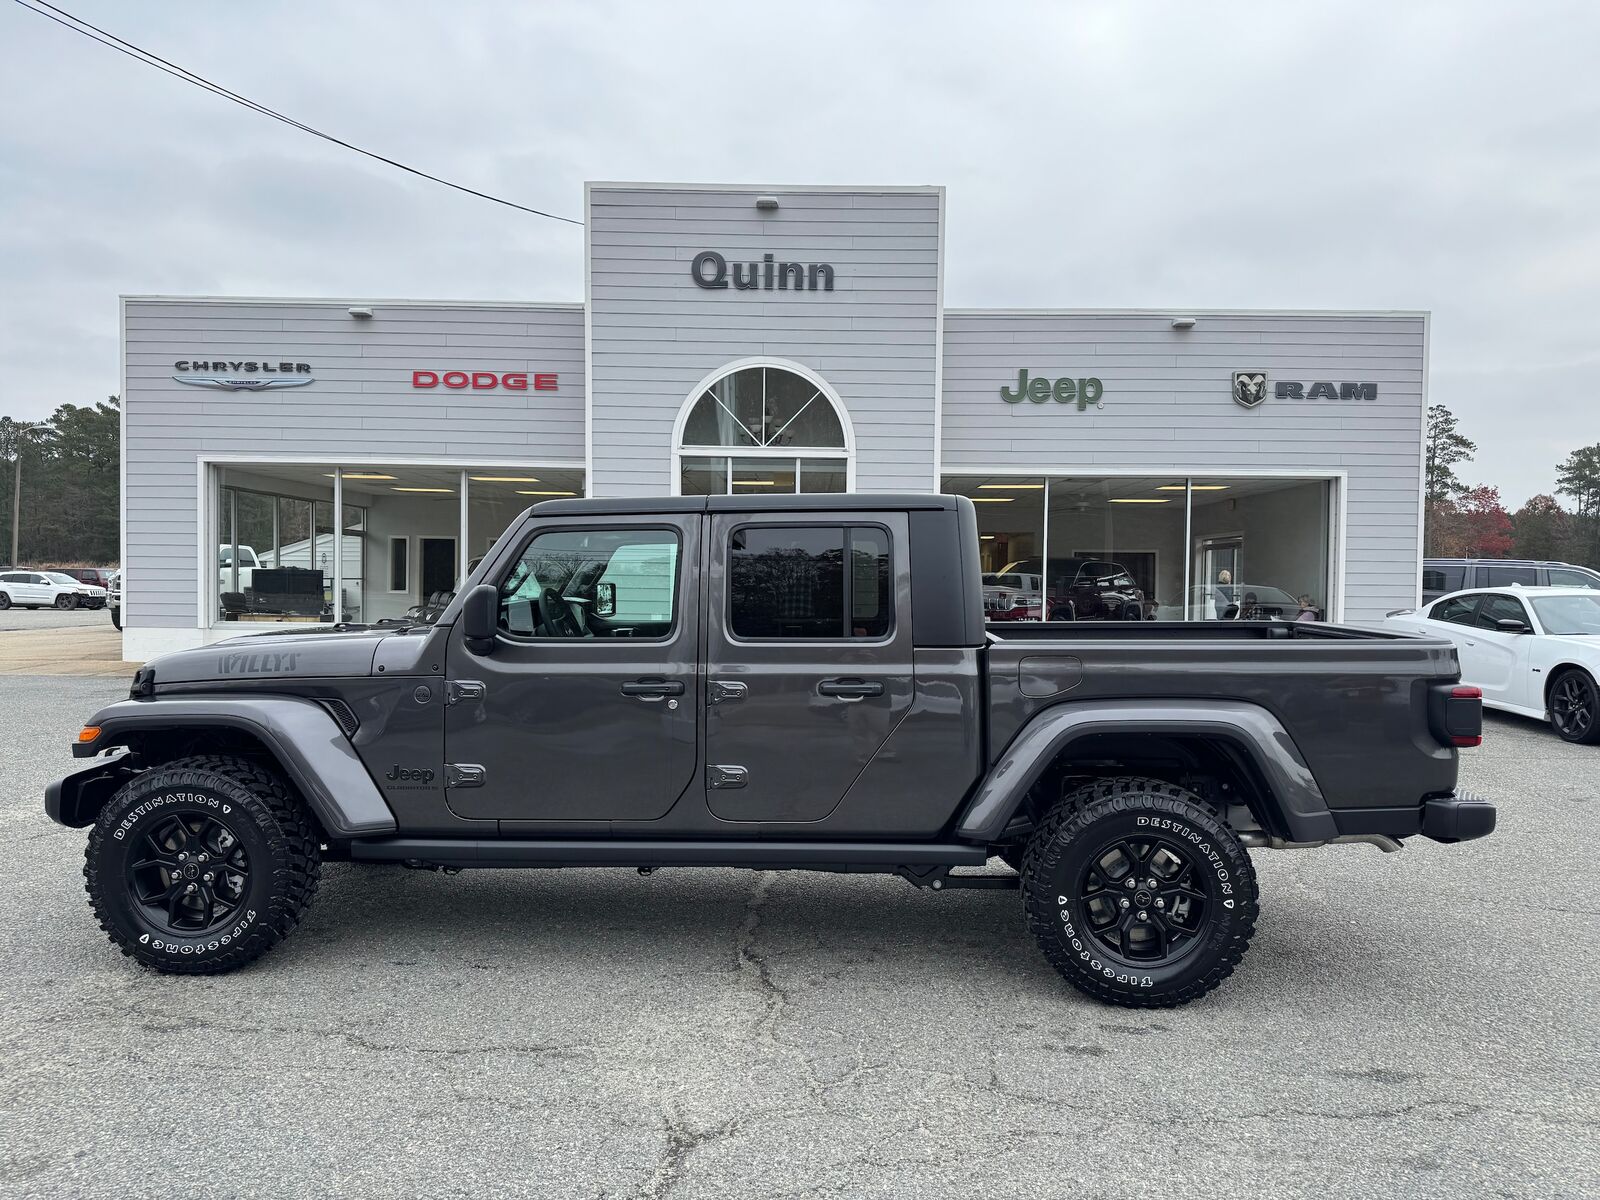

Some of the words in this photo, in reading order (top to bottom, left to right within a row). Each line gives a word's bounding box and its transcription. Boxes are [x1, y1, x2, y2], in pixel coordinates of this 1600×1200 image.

[691, 250, 834, 291] Quinn
[174, 360, 311, 375] CHRYSLER
[412, 370, 560, 391] DODGE
[1000, 368, 1104, 411] Jeep
[1275, 381, 1378, 401] RAM
[217, 652, 301, 674] WILLYS
[385, 763, 435, 785] Jeep
[113, 793, 220, 840] DESTINATION
[1137, 816, 1233, 895] DESTINATION
